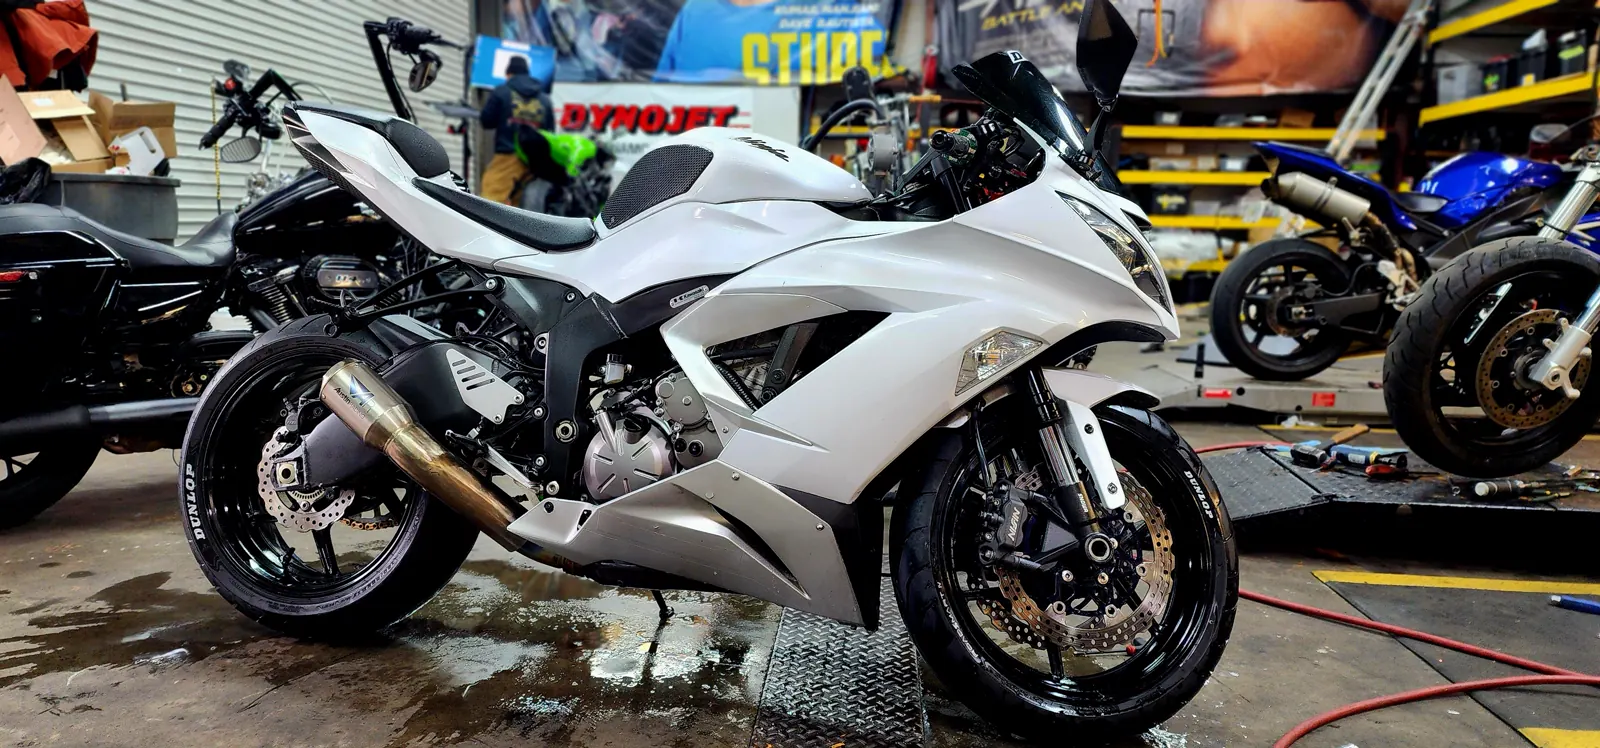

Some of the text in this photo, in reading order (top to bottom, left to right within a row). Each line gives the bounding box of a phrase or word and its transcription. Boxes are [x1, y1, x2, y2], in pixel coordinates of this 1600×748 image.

[981, 6, 1050, 31] BATTLE
[742, 30, 895, 86] STUBE
[559, 102, 738, 134] DYNOJET
[729, 136, 790, 163] Ninja
[185, 463, 206, 540] DUNLOP
[1183, 470, 1214, 519] DUNLOP
